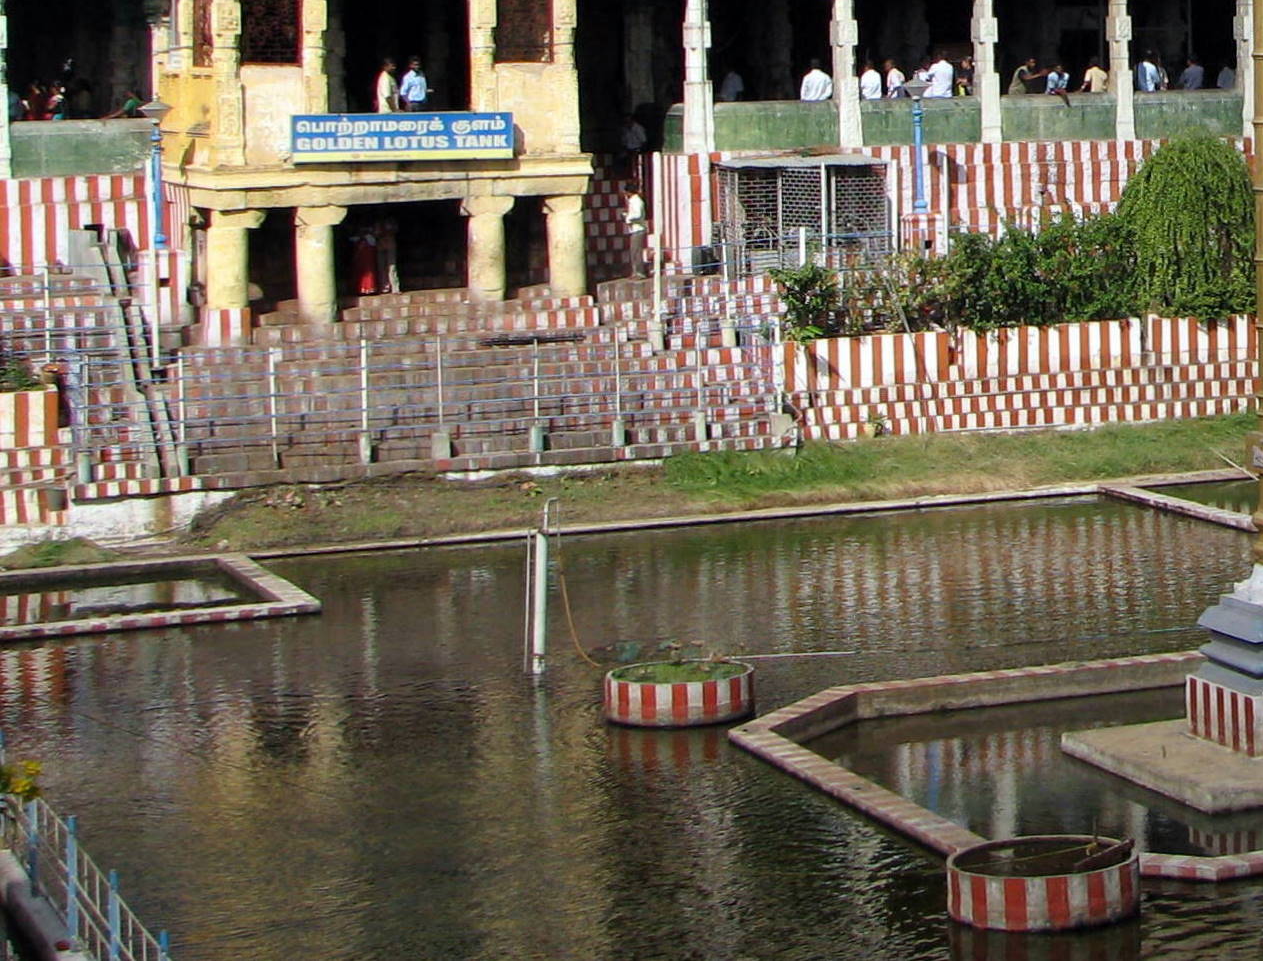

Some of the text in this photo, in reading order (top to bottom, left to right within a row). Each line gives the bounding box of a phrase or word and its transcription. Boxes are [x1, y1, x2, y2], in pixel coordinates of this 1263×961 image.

[296, 116, 506, 136] பொற்றாமரைக் குளம்
[296, 134, 508, 150] GOLDEN LOTUS TANK
